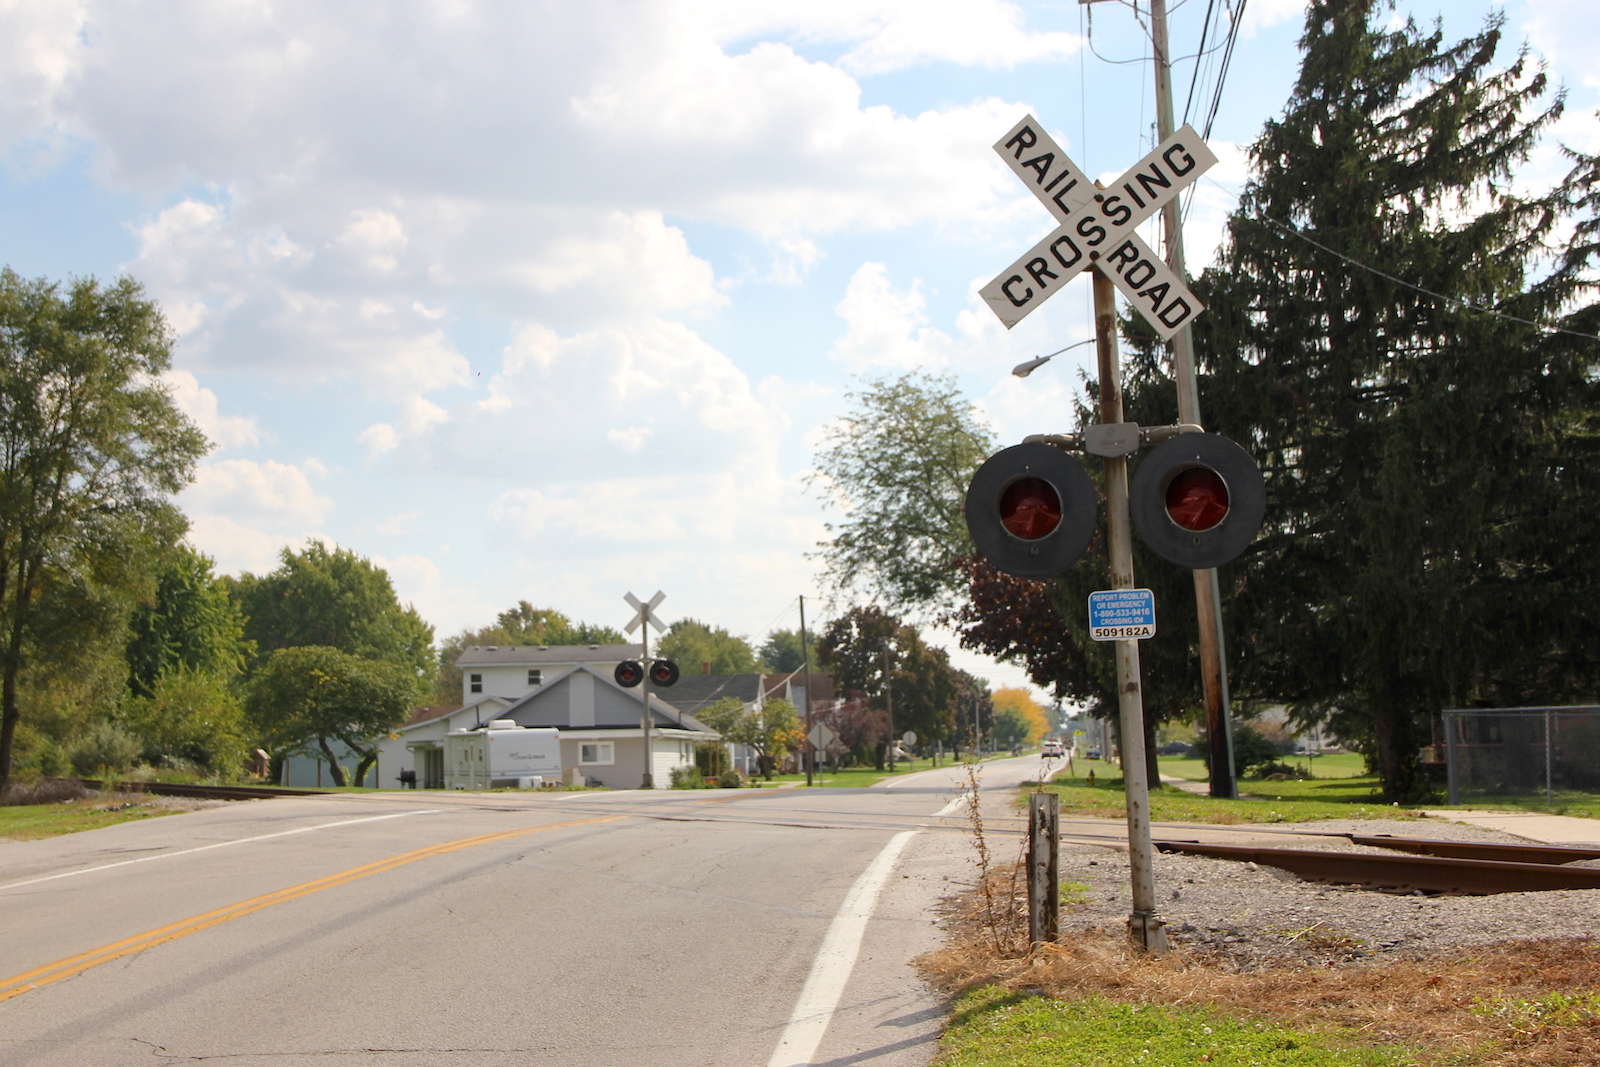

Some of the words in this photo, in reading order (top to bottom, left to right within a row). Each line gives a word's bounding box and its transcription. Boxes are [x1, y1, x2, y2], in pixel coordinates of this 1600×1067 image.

[1001, 143, 1196, 307] CROSSING
[1004, 125, 1078, 215] RAIL
[1106, 240, 1192, 329] ROAD
[1107, 600, 1146, 609] EMERGENCY
[1094, 608, 1150, 618] 1-800-533-9416
[1095, 627, 1150, 637] 509182A
